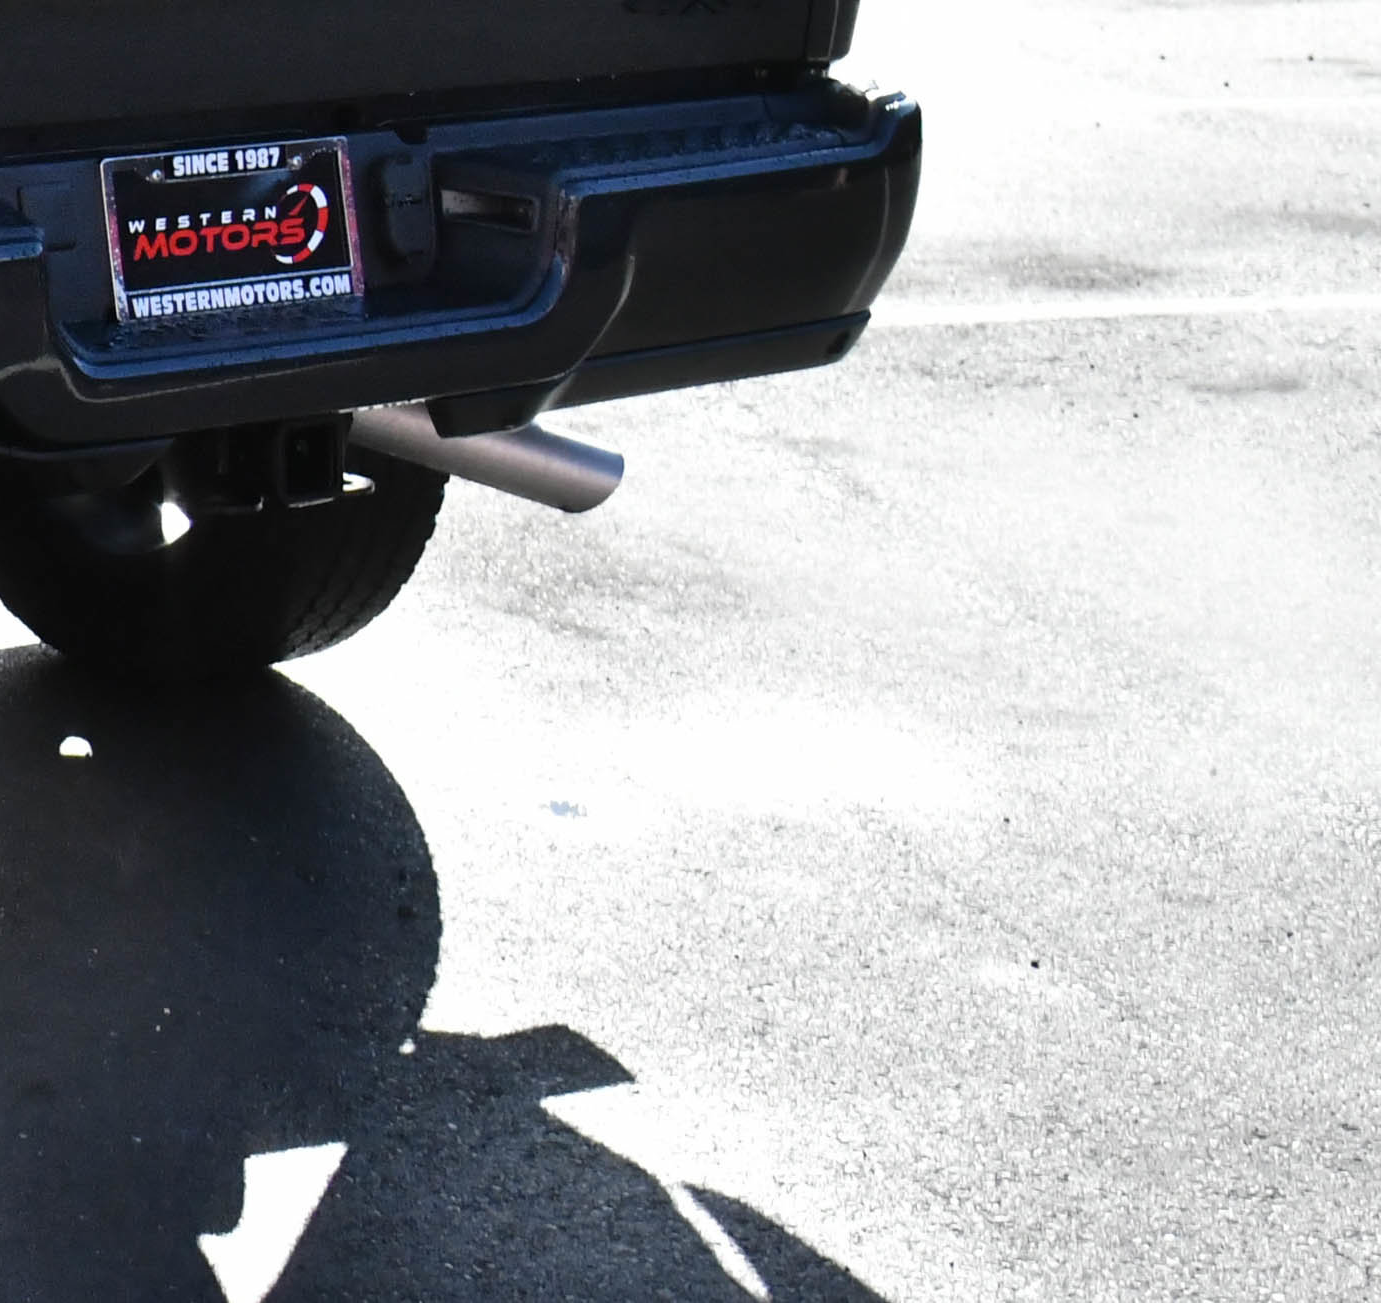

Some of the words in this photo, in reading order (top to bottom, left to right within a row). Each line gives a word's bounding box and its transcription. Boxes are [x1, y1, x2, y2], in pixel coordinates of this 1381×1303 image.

[172, 151, 229, 177] SINCE
[235, 146, 281, 171] 1987
[127, 205, 277, 234] WESTERN
[133, 217, 305, 261] MOTORS
[131, 273, 352, 319] WESTERNMOTORS.COM
